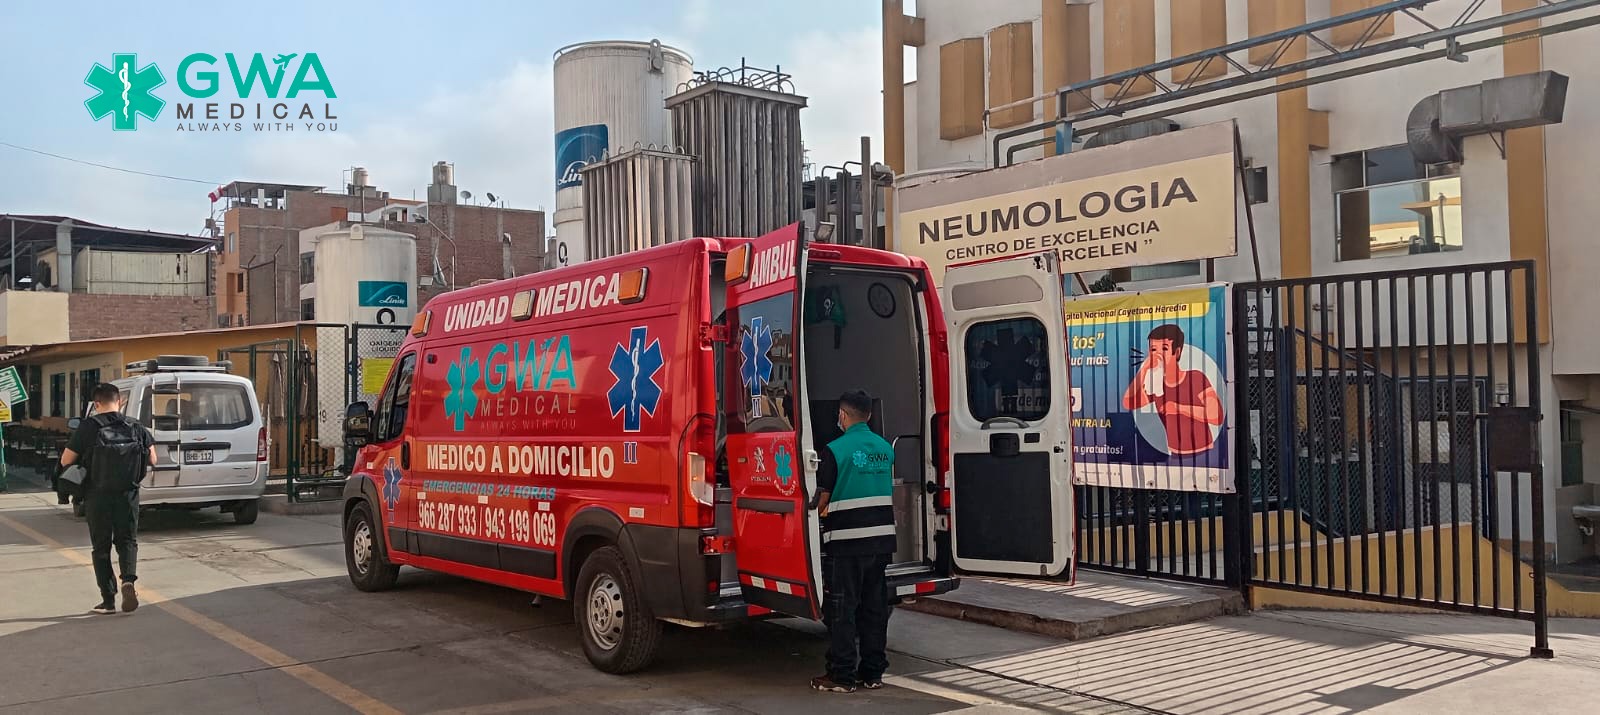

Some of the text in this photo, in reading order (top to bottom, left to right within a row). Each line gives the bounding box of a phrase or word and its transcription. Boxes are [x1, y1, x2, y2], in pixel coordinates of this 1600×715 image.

[558, 161, 588, 185] Lin
[919, 177, 1198, 244] NEUMOLOGIA
[945, 219, 1161, 260] CENTRO DE EXCELENCIA
[1060, 241, 1137, 262] RCELEN
[750, 240, 796, 289] AMBUL
[444, 272, 620, 332] UNIDAD MEDICA
[1066, 304, 1187, 320] pital Nacional Cayetano Heredia
[484, 335, 576, 393] GWA
[1086, 354, 1109, 366] más
[480, 394, 576, 417] MEDICAL
[522, 419, 548, 430] WITH
[552, 418, 576, 430] YOU
[1072, 418, 1112, 428] NTRA LA
[426, 444, 615, 478] MEDICO A DOMICILIO
[868, 453, 888, 462] GWA
[1080, 444, 1124, 455] gratuitos!
[422, 480, 556, 500] EMERGENCIAS 24 HORAS
[418, 500, 435, 530] 966
[438, 502, 456, 532] 287
[458, 504, 477, 536] 933
[485, 507, 506, 540] 943
[508, 509, 530, 543] 199
[532, 511, 556, 547] 069
